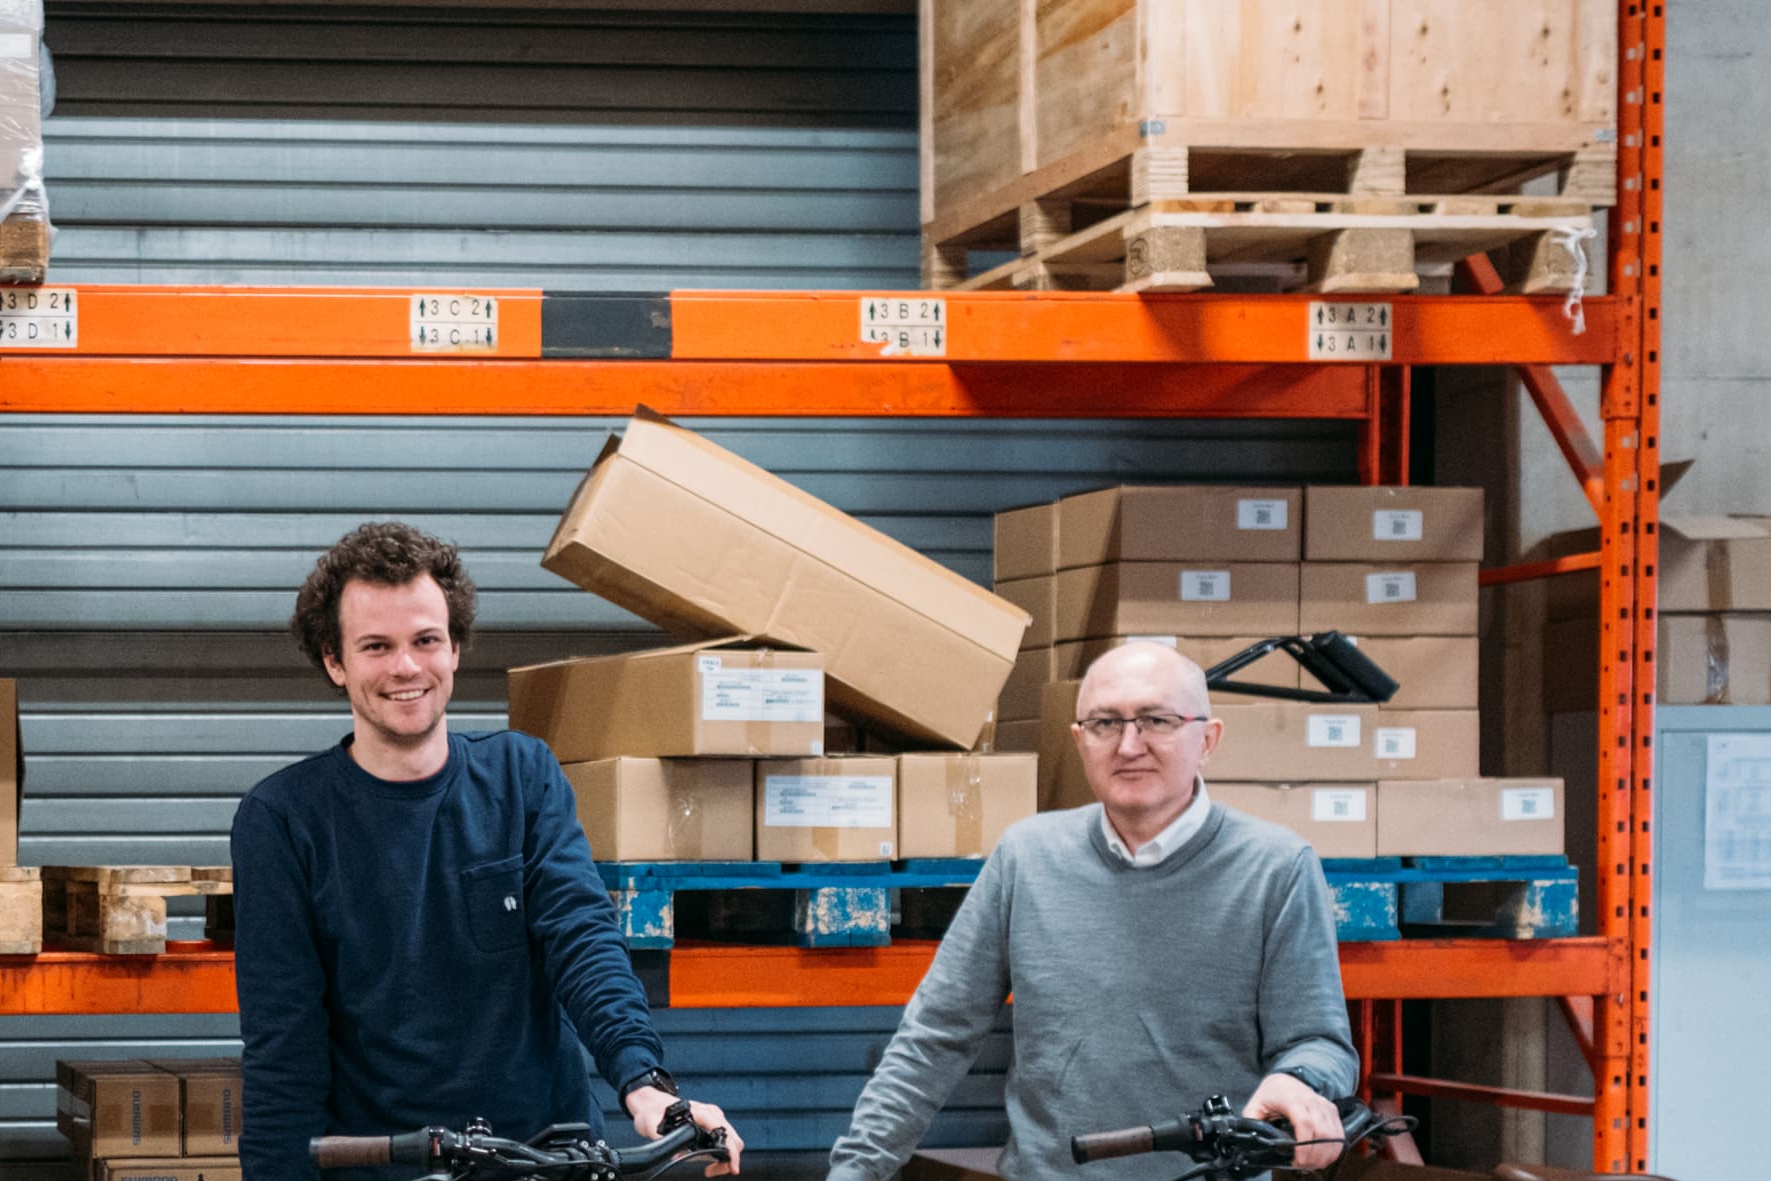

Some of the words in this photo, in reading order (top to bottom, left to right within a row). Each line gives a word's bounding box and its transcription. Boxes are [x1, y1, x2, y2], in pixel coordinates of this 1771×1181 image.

[8, 293, 17, 309] 3
[28, 293, 37, 309] D
[50, 293, 58, 309] 2
[431, 299, 439, 316] 3
[450, 300, 460, 316] C
[472, 299, 479, 316] 2
[881, 303, 888, 319] 3
[900, 304, 908, 319] B
[921, 303, 928, 319] 2
[1329, 307, 1336, 323] 3
[1347, 307, 1356, 323] A
[1367, 307, 1375, 323] 2
[8, 323, 17, 339] 3
[29, 323, 38, 339] D
[430, 329, 439, 343] 3
[450, 329, 460, 345] C
[900, 332, 908, 347] B
[1329, 336, 1336, 352] 3
[1347, 336, 1355, 352] A
[132, 1090, 142, 1146] SHIMANO
[222, 1088, 232, 1145] SHIMANO
